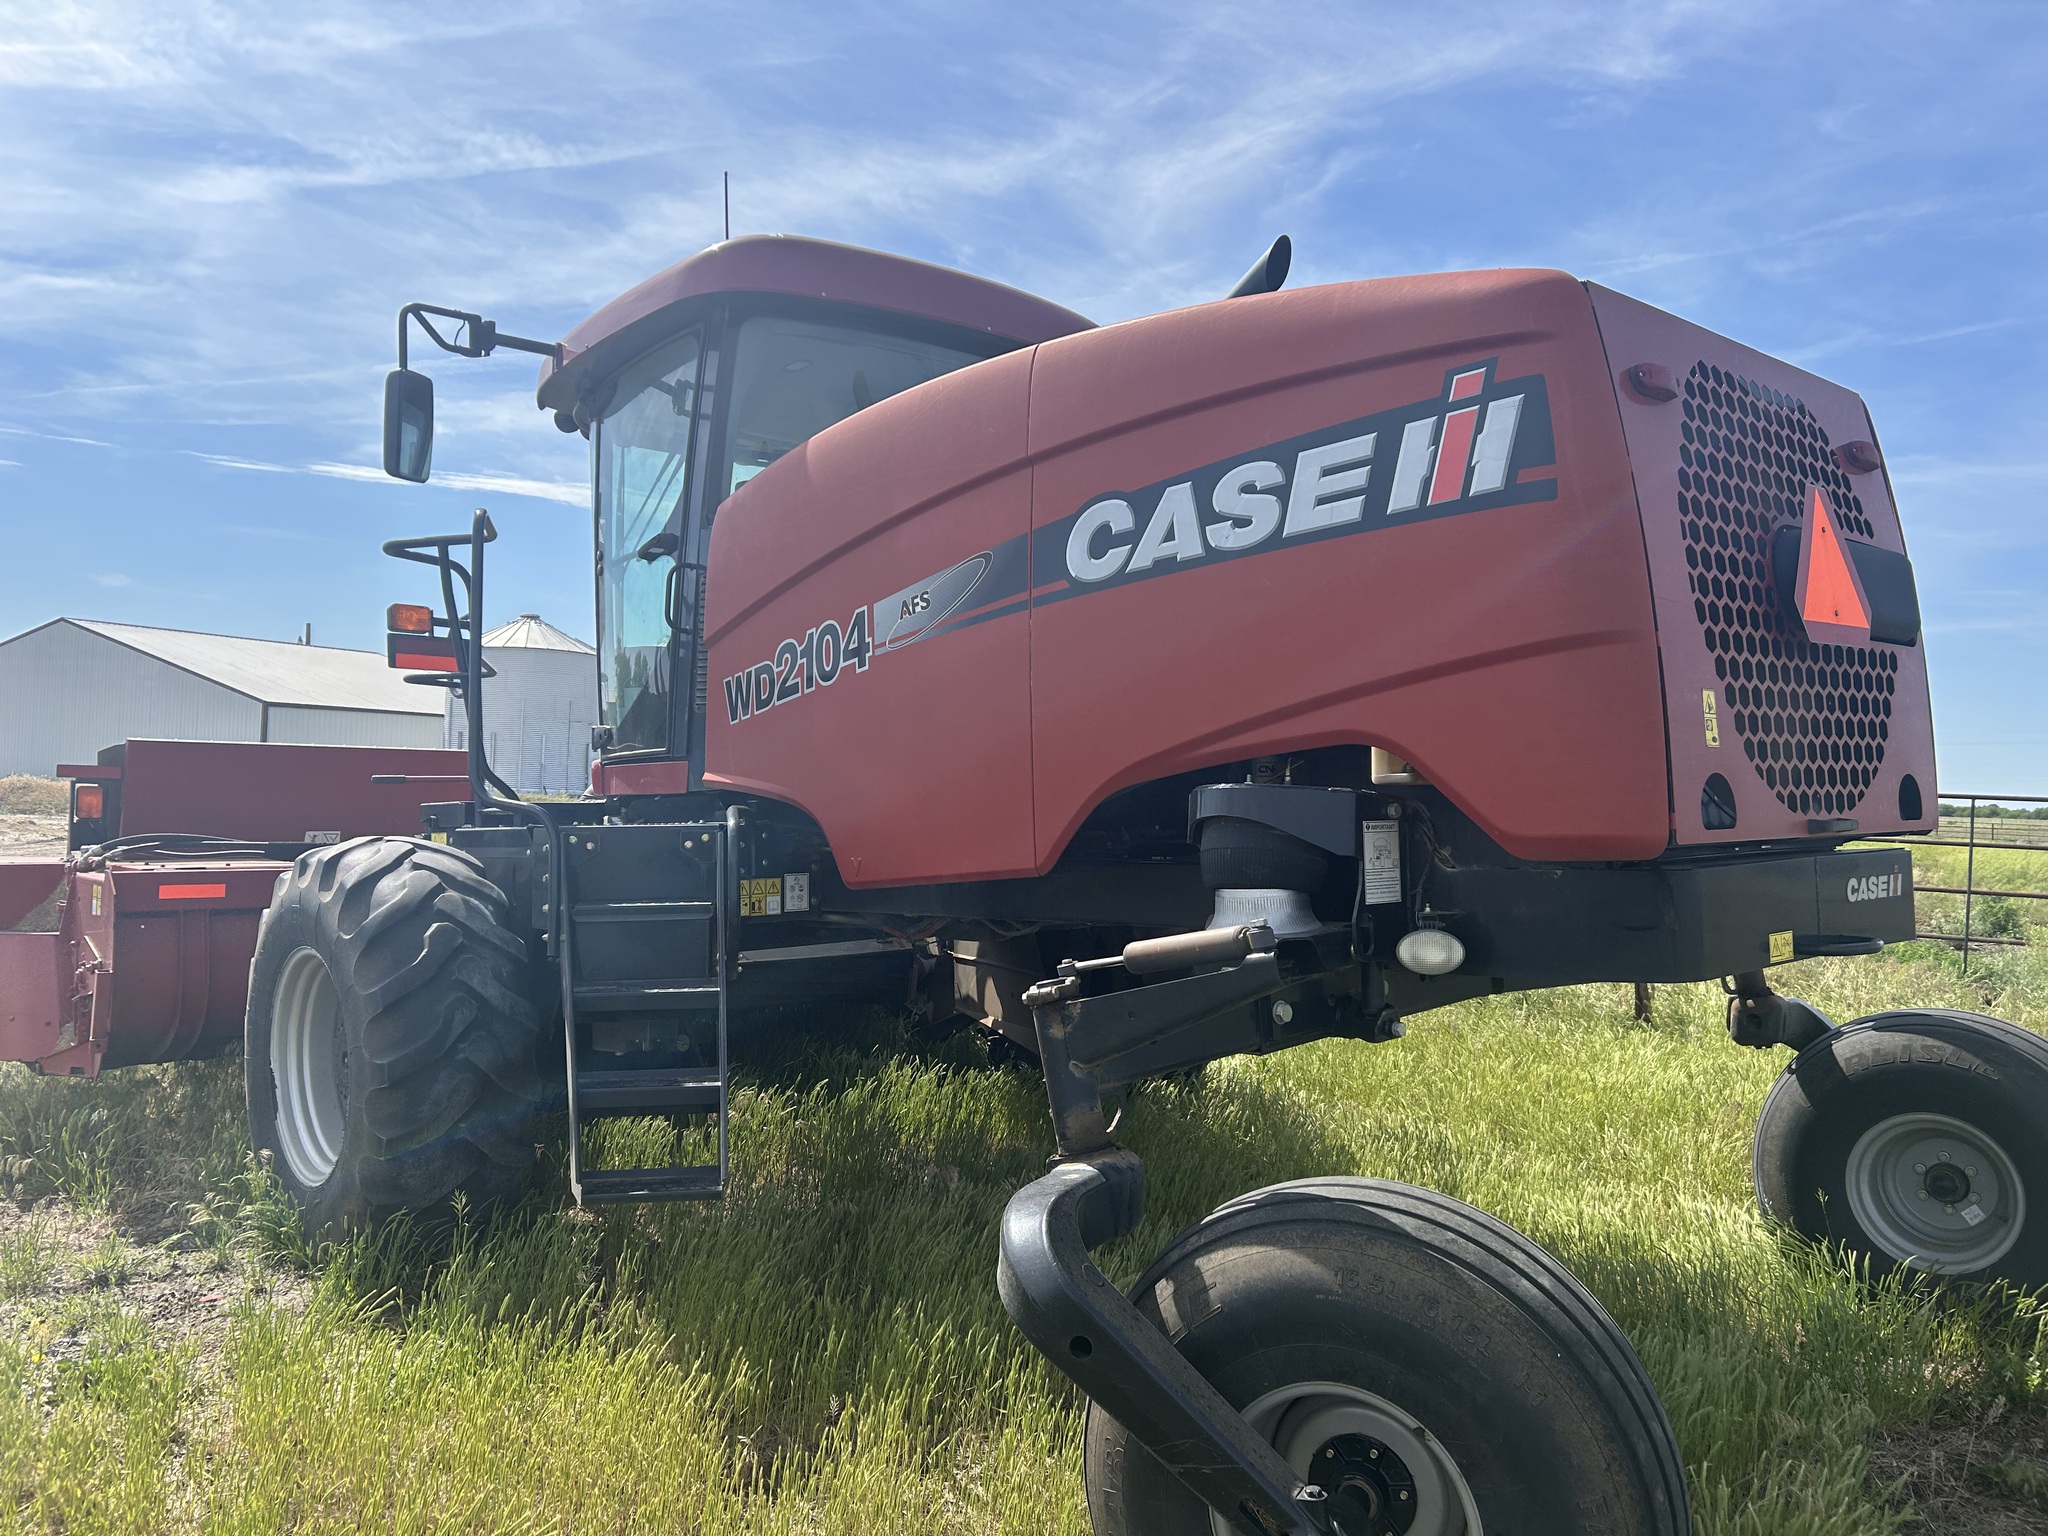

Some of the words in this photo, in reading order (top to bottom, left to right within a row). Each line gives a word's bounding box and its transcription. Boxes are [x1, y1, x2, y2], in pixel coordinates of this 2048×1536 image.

[1066, 432, 1377, 582] CASE
[899, 590, 931, 620] AFS
[723, 605, 872, 724] WD2104
[1370, 823, 1396, 831] IMPORTANT
[1847, 875, 1888, 902] CASE
